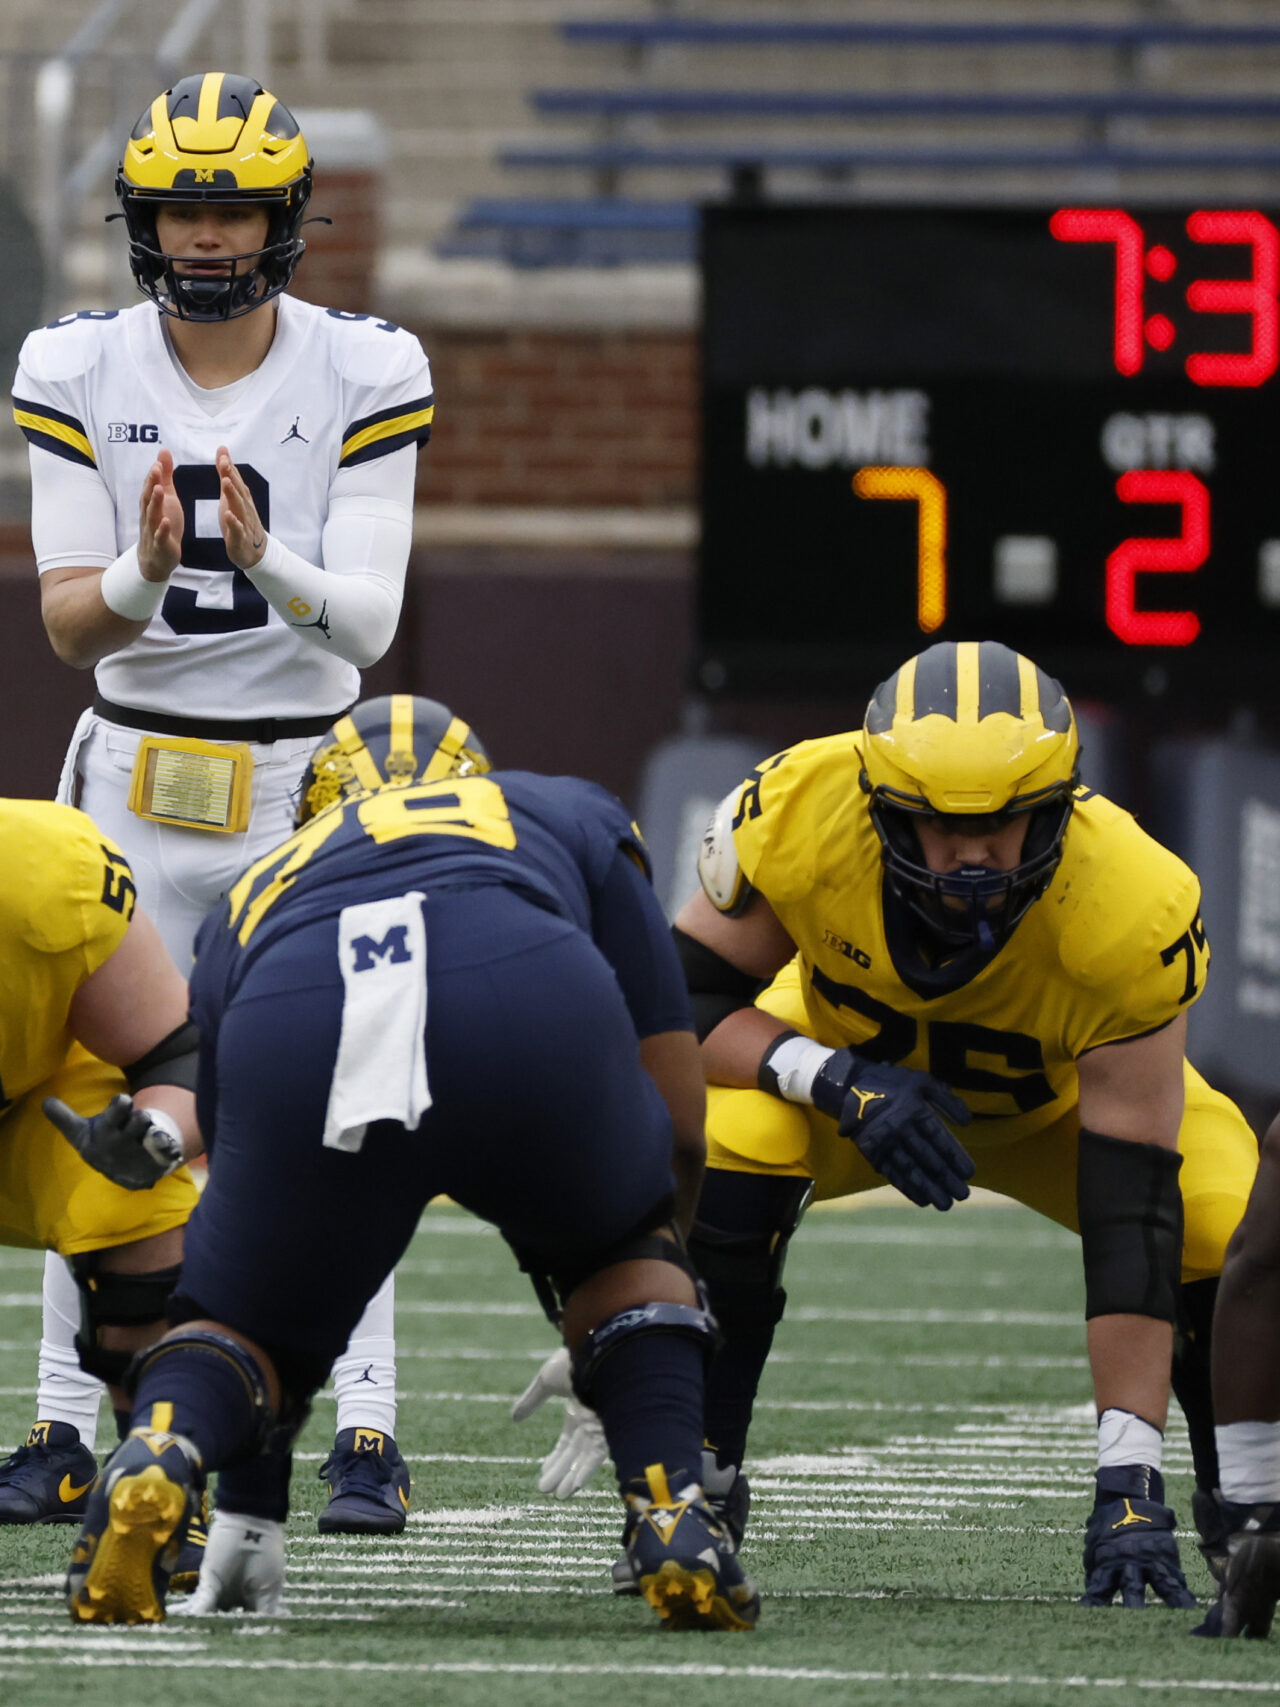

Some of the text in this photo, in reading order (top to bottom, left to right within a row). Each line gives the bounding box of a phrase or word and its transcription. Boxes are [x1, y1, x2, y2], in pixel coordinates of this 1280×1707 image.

[194, 168, 215, 183] M
[746, 387, 930, 470] HOME
[161, 463, 269, 635] 9
[852, 466, 946, 633] 7
[1105, 470, 1210, 645] 2
[350, 924, 413, 974] M
[811, 964, 1060, 1118] 75
[27, 1426, 46, 1445] M
[357, 1434, 381, 1451] M
